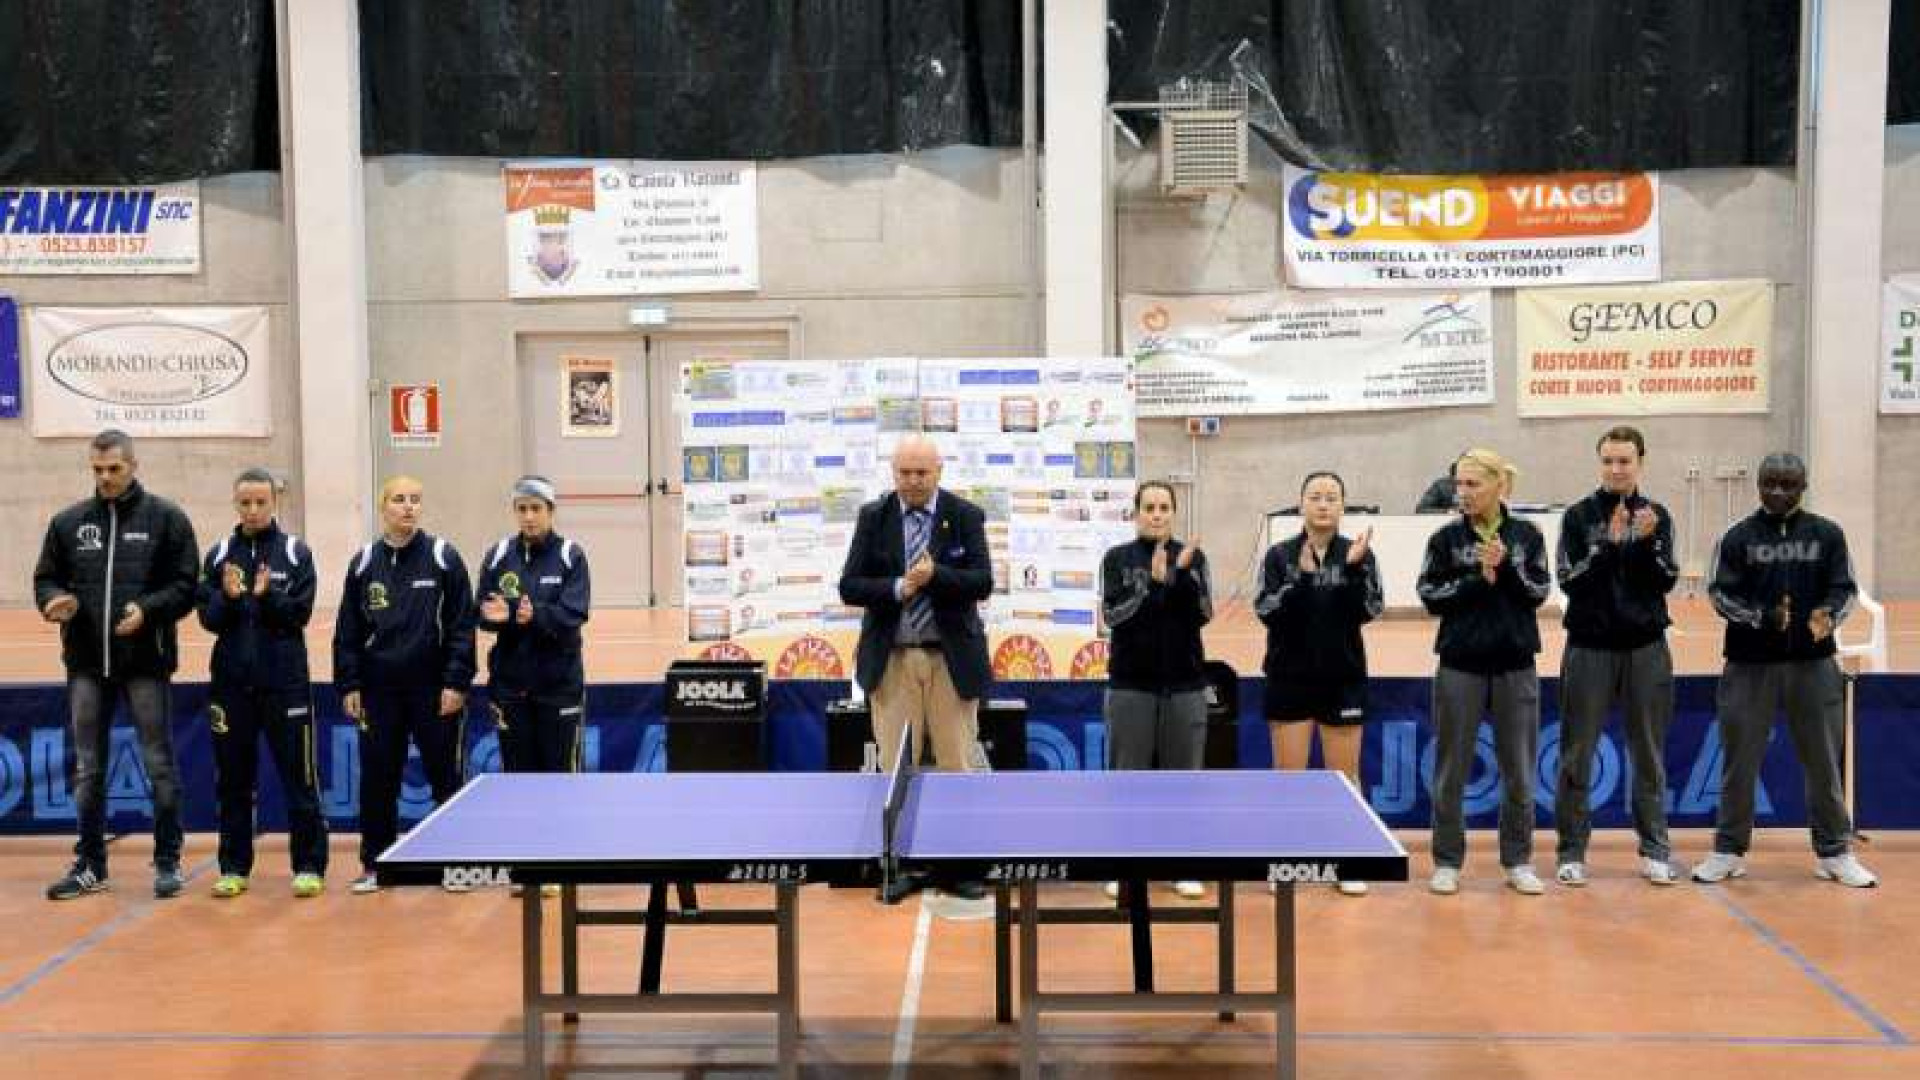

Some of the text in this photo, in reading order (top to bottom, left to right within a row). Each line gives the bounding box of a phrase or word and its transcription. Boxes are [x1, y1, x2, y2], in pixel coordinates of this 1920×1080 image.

[1308, 181, 1626, 231] SUEND VIAGGI
[1297, 251, 1323, 263] VIA
[1329, 251, 1428, 262] TORRICELLA
[1466, 248, 1608, 262] CORTEMAGGIORE
[1612, 244, 1645, 258] (PC)
[1376, 267, 1419, 279] TEL.
[1569, 300, 1717, 342] GEMCO
[1532, 352, 1630, 370] RISTORANTE
[1648, 349, 1683, 368] SELF
[1689, 348, 1755, 367] SERVICE
[1530, 377, 1570, 395] CORTE
[676, 681, 748, 699] JOOLA
[442, 867, 512, 885] JOOLA
[1267, 864, 1339, 882] JOOLA
